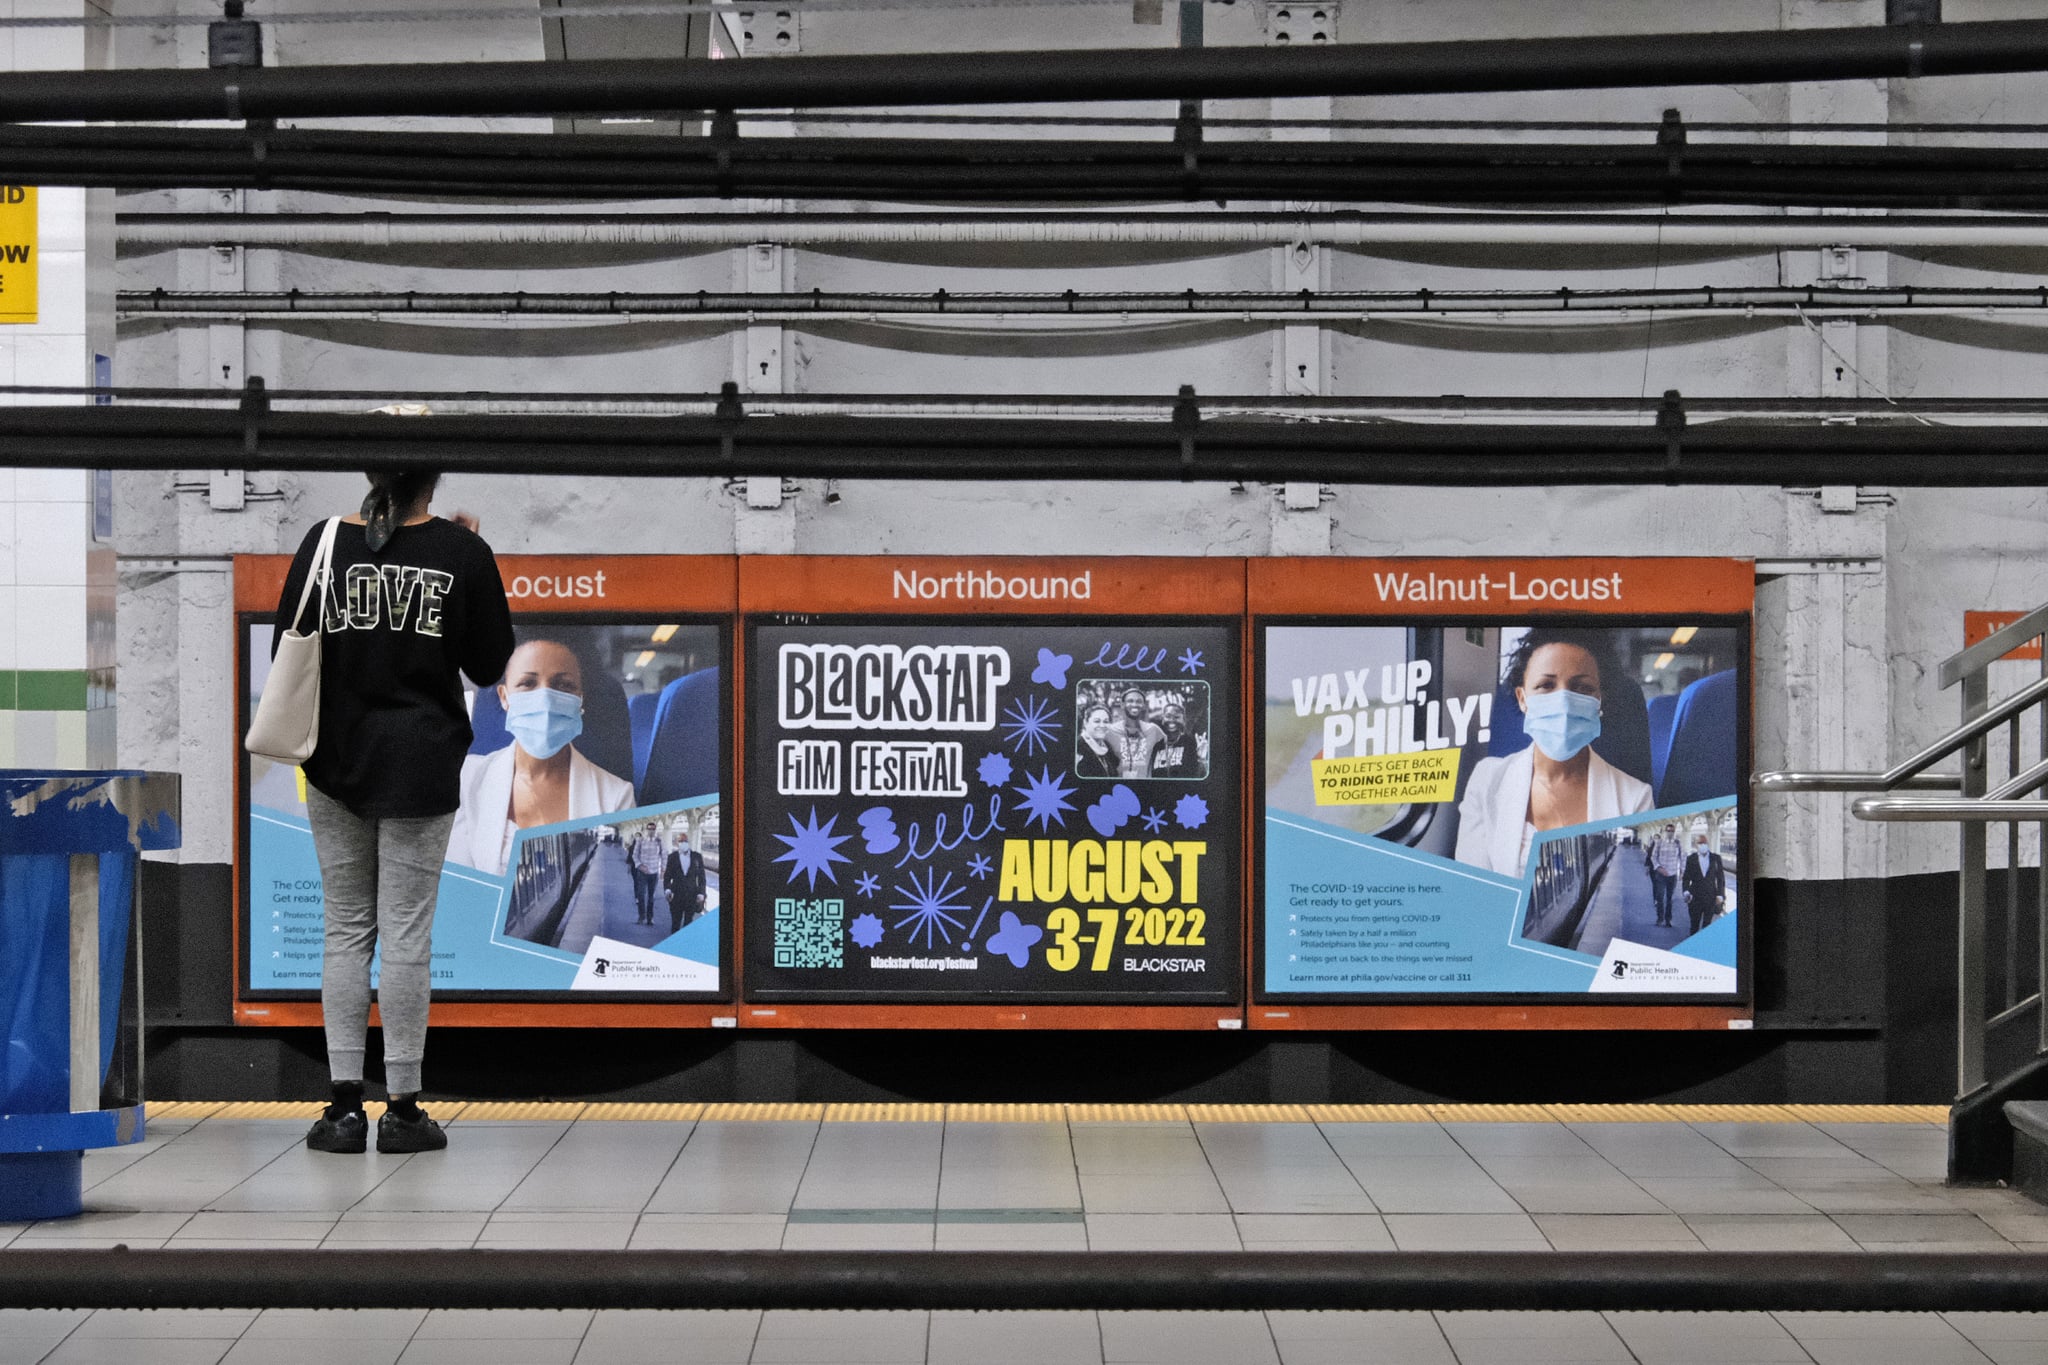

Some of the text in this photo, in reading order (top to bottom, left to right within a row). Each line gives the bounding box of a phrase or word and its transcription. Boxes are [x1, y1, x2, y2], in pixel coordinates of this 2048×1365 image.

[505, 570, 606, 598] ocust
[893, 570, 1091, 599] Northbound
[1373, 572, 1622, 601] Walnut-Locust
[316, 564, 453, 637] LOVE
[1292, 659, 1432, 717] VAX UP,
[1323, 693, 1492, 759] PHILLY!
[1324, 757, 1443, 775] AND LET'S GET BACK
[1320, 770, 1450, 788] TO RIDING THE TRAIN
[1335, 784, 1438, 801] TOGETHER AGAIN
[998, 839, 1207, 904] AUGUST
[272, 880, 292, 890] The
[1289, 883, 1309, 893] The
[1311, 883, 1364, 893] COVID-19
[1366, 884, 1405, 893] vaccine
[1407, 884, 1416, 893] is
[272, 893, 322, 905] Get ready
[1289, 897, 1308, 907] Get
[1310, 897, 1338, 908] ready
[1341, 898, 1352, 906] to
[1354, 898, 1371, 908] get
[283, 911, 316, 919] Protects
[1334, 916, 1349, 924] you
[1372, 915, 1400, 924] getting
[283, 926, 306, 935] Safely
[1300, 929, 1323, 938] Safely
[1325, 929, 1347, 937] taken
[1349, 930, 1358, 938] by
[1367, 929, 1382, 937] half
[1390, 929, 1417, 937] million
[1046, 907, 1206, 971] 3-7 2022
[1300, 941, 1356, 949] Philadelphians
[1373, 942, 1389, 950] you
[1415, 941, 1450, 949] counting
[283, 951, 320, 961] Helps get
[1300, 955, 1321, 963] Helps
[1324, 955, 1337, 964] get
[1396, 955, 1420, 964] things
[1123, 958, 1206, 972] BLACKSTAR
[272, 971, 322, 979] Learn more
[440, 970, 454, 978] 311
[1289, 973, 1314, 982] Learn
[1316, 974, 1338, 982] more
[1340, 974, 1349, 982] at
[1440, 973, 1455, 982] call
[1457, 973, 1472, 982] 311
